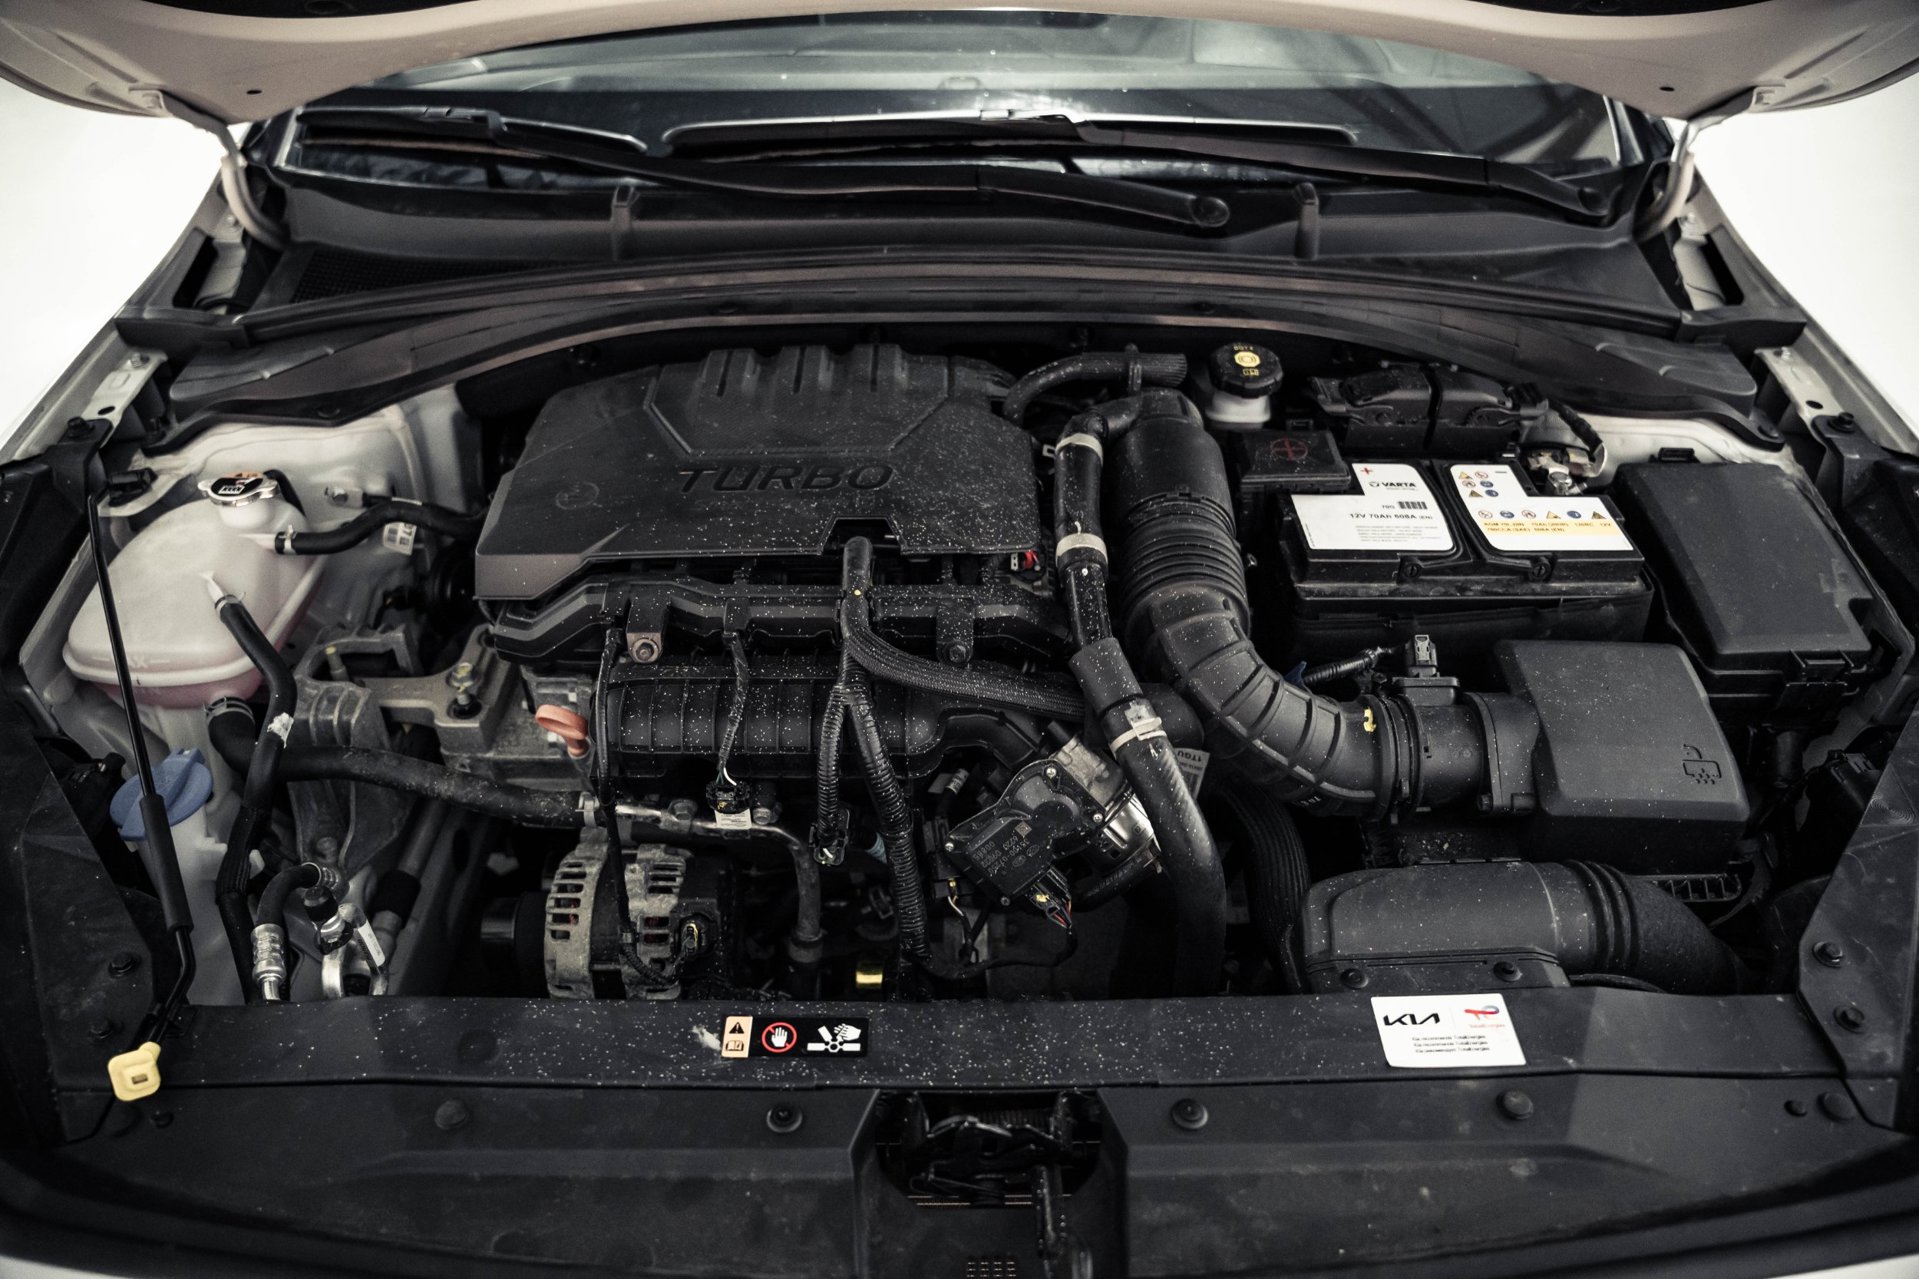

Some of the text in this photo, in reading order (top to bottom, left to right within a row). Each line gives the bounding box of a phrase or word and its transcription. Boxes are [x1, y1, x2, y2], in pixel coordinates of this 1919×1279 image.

[679, 464, 894, 494] TURBO
[1177, 750, 1202, 762] 1TGU
[1383, 1012, 1440, 1026] KIA
